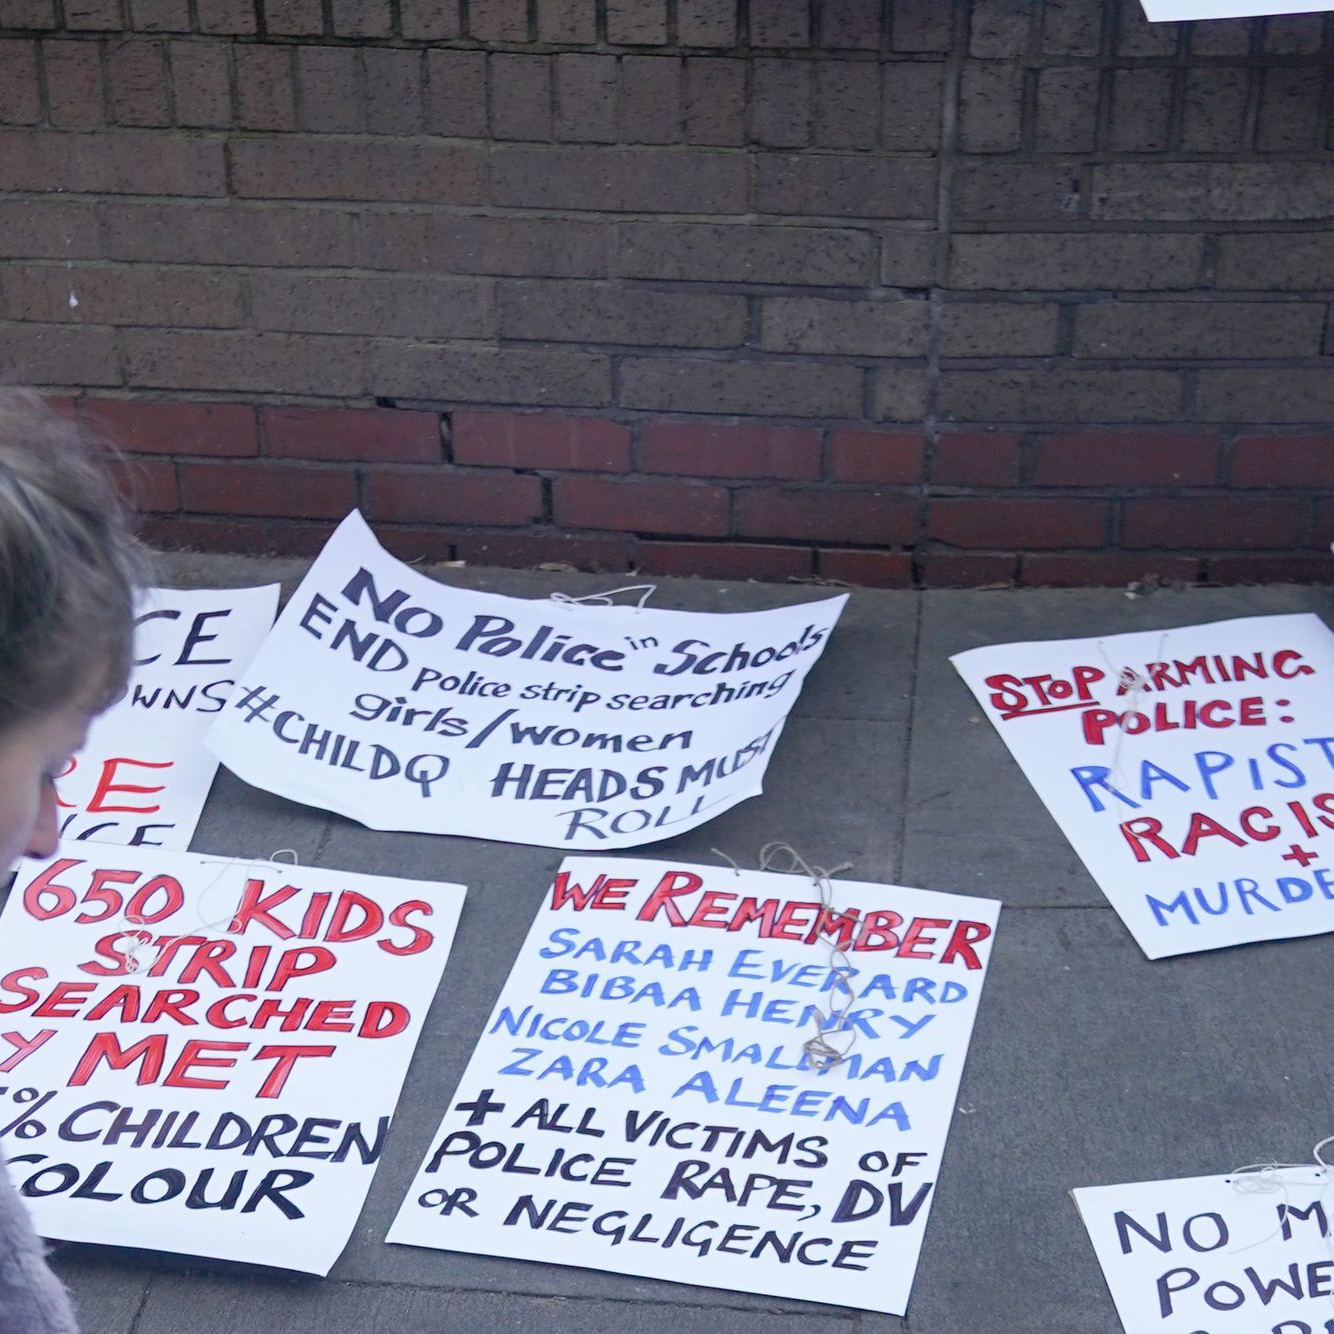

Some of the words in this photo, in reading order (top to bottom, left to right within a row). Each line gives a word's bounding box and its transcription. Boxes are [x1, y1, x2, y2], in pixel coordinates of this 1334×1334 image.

[299, 592, 409, 672] END
[520, 683, 600, 713] strip
[606, 668, 797, 711] searching
[455, 613, 627, 673] Police
[624, 635, 659, 651] in
[653, 623, 829, 677] Schools
[1114, 657, 1317, 698] ARMING
[234, 685, 450, 798] #CHILDQ
[489, 761, 669, 803] HEADS
[1081, 697, 1295, 745] POLICE:
[553, 794, 732, 841] ROLL
[22, 858, 185, 925] 650
[226, 879, 435, 956] KIDS
[550, 872, 637, 913] WE
[636, 870, 993, 971] REMEMBER
[76, 930, 338, 992] STRIP
[538, 927, 713, 972] SARAH
[728, 949, 968, 1005] EVERARD
[490, 1005, 649, 1050] NICOLE
[540, 968, 702, 1014] BIBAA
[720, 989, 937, 1040] HENRY
[67, 1032, 338, 1099] MET
[497, 1047, 647, 1095] ZARA
[671, 1071, 914, 1132] ALEENA
[57, 1100, 390, 1166] CHILDREN
[455, 1088, 506, 1127] +
[511, 1097, 605, 1139] ALL
[625, 1108, 828, 1171] VICTIMS
[858, 1150, 928, 1177] OF
[425, 1131, 636, 1189] POLICE
[660, 1159, 821, 1221] RAPE,
[832, 1179, 934, 1228] DV
[417, 1187, 480, 1220] OR
[503, 1193, 879, 1273] NEGLIGENCE
[1113, 1210, 1230, 1256] NO
